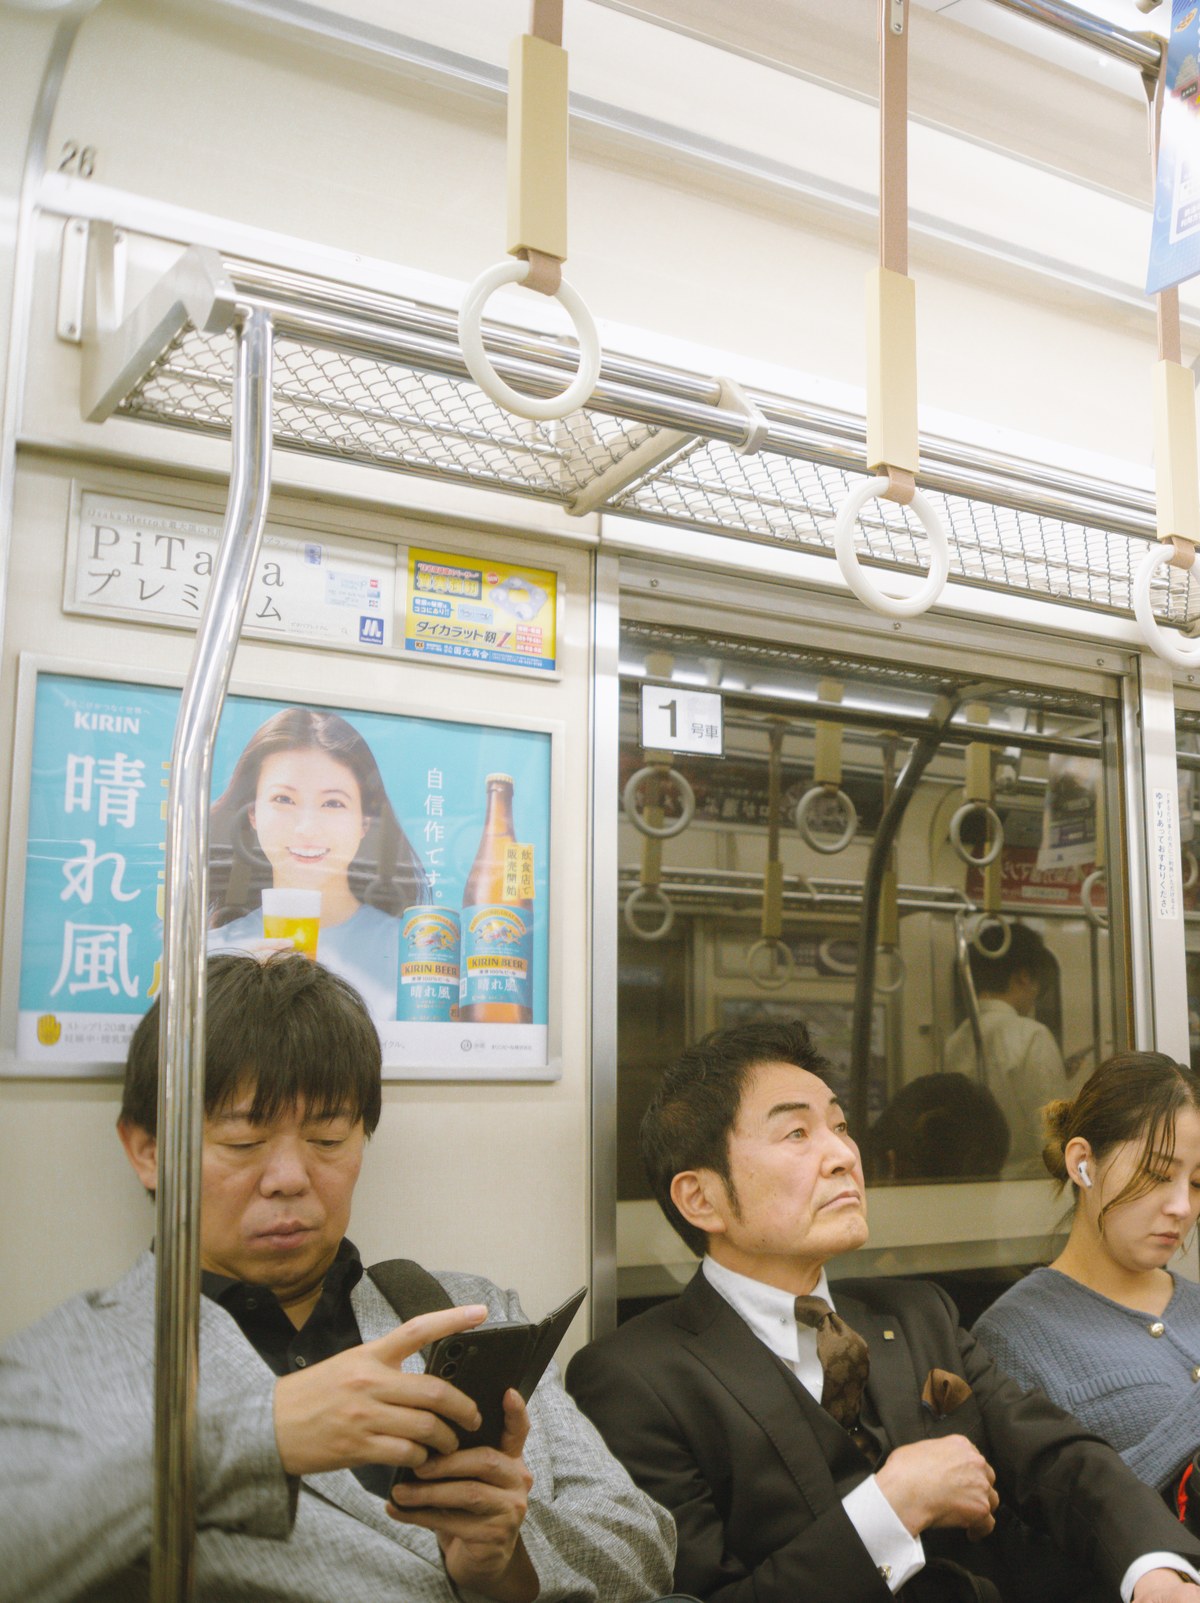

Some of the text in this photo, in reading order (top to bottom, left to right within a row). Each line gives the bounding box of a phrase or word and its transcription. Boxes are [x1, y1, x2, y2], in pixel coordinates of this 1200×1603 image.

[88, 523, 285, 588] PiTaa
[87, 568, 283, 623] プレミム
[74, 710, 140, 735] KIRIN
[658, 699, 719, 740] 1 号車
[423, 767, 445, 899] 自信作です。
[49, 752, 147, 999] 晴れ風
[404, 964, 434, 975] KIRIN
[472, 957, 525, 970] KIRIN BEER
[410, 985, 451, 1000] 晴れ風
